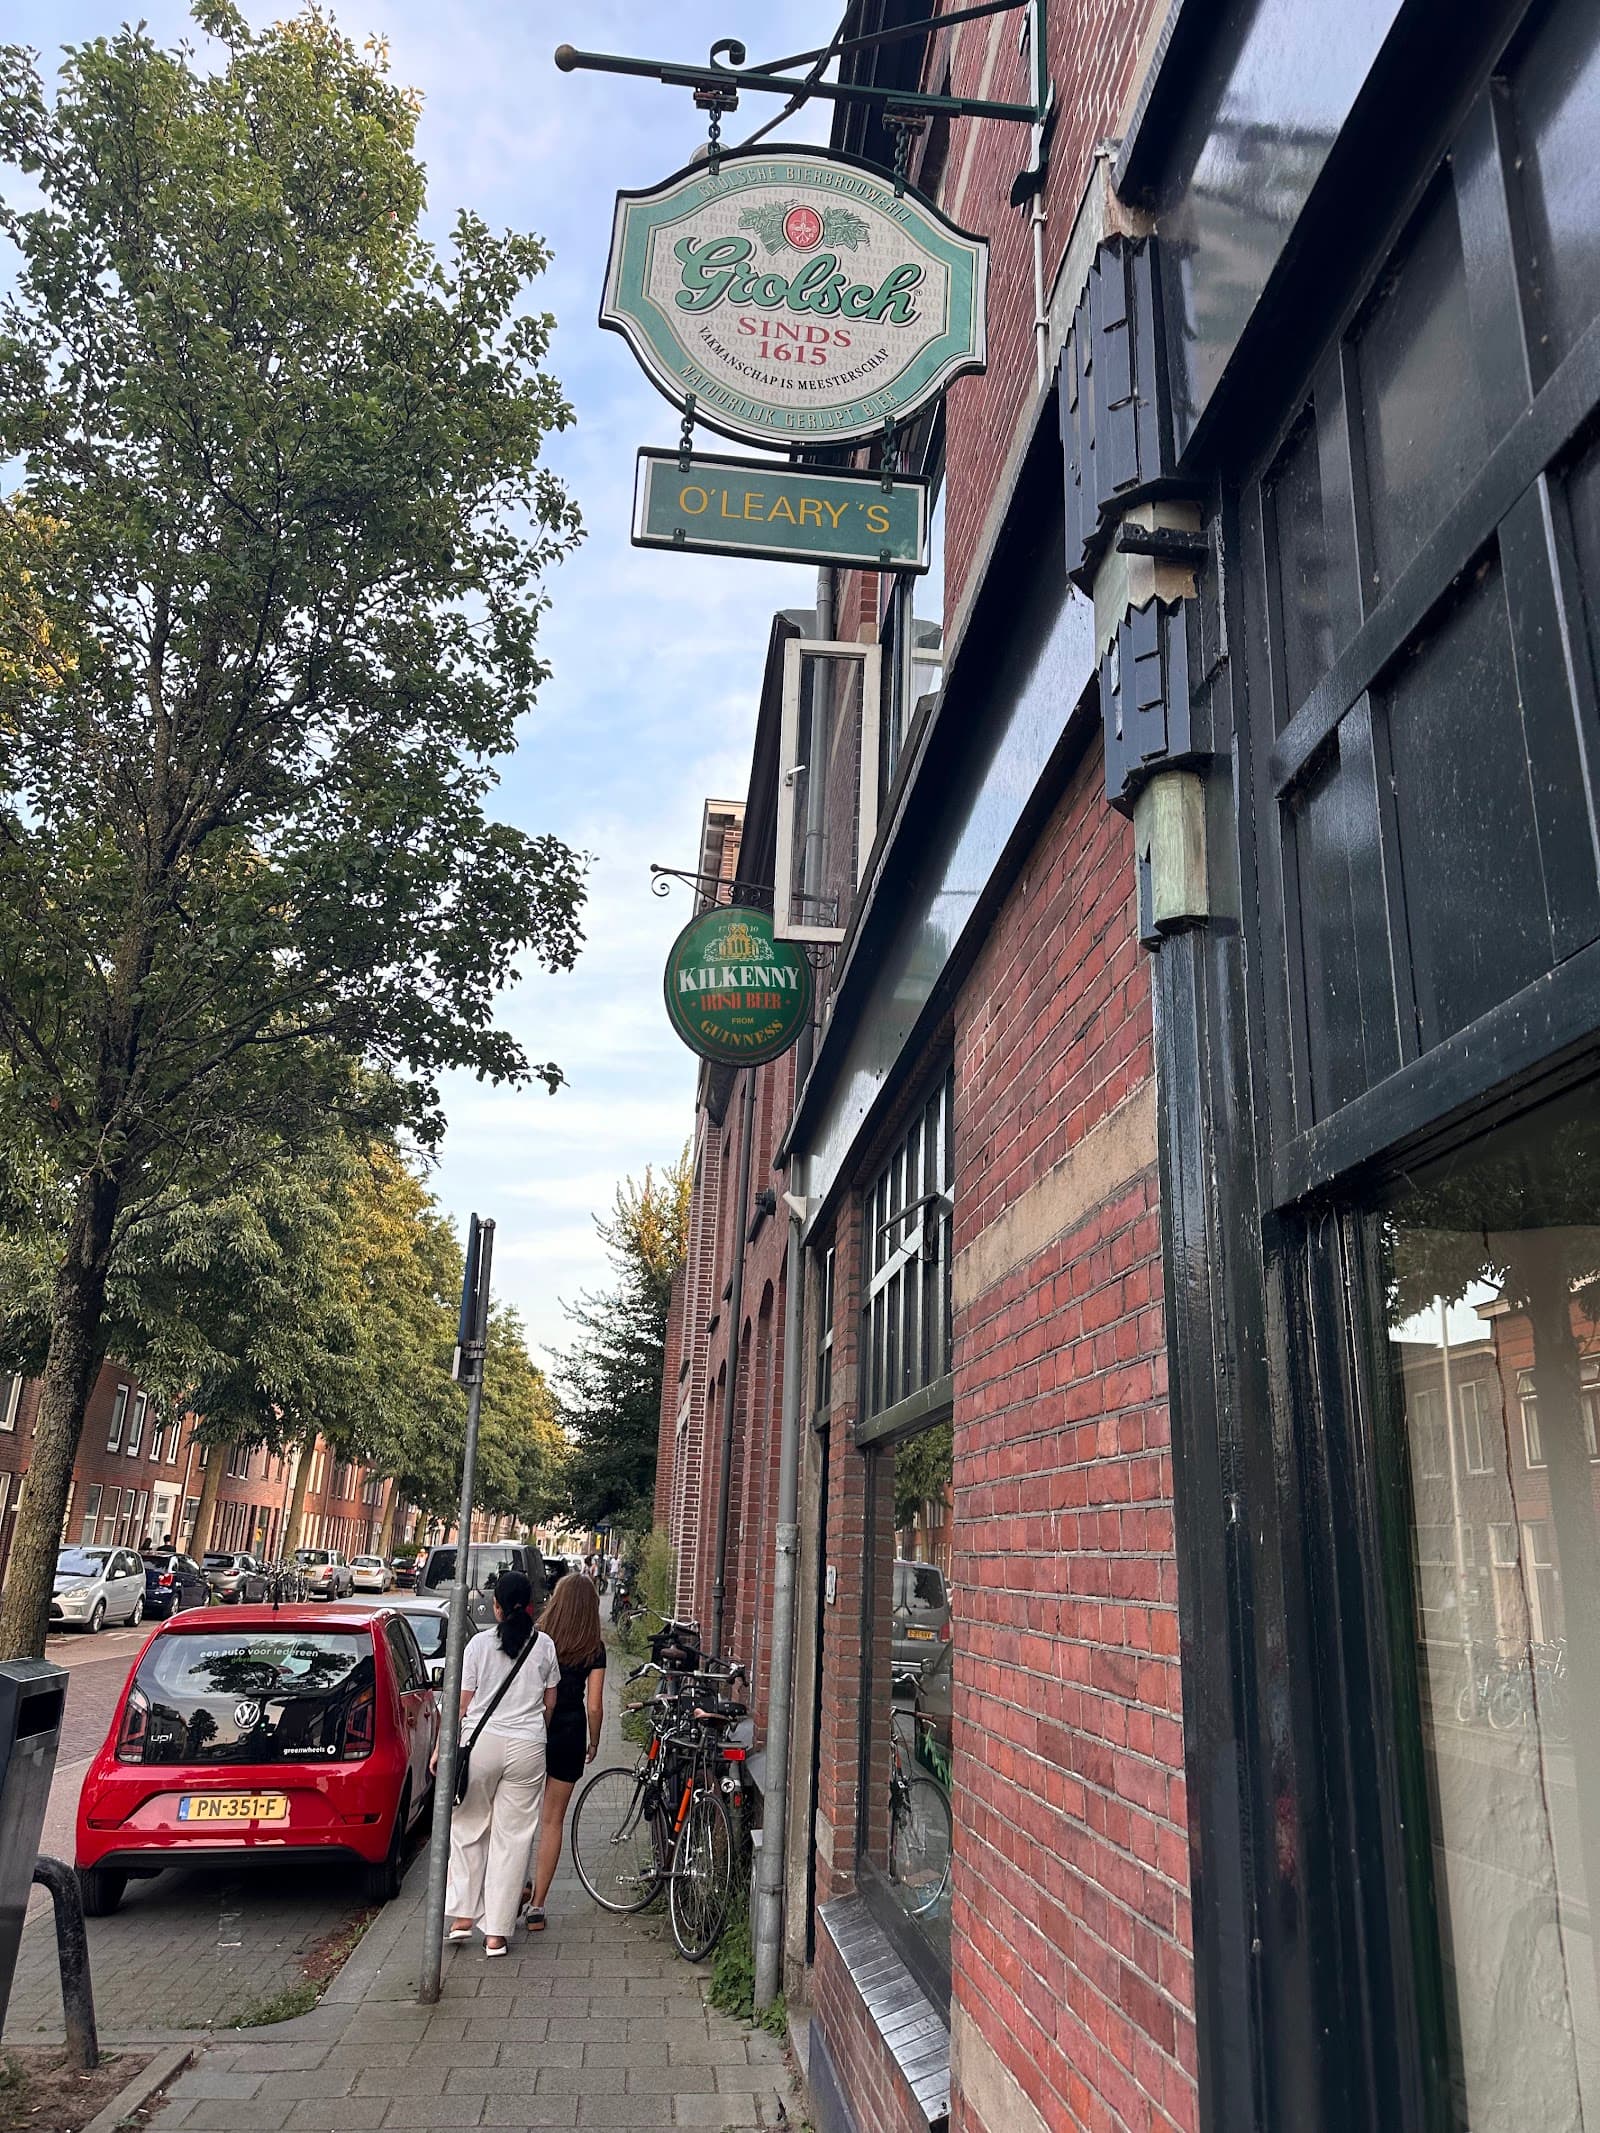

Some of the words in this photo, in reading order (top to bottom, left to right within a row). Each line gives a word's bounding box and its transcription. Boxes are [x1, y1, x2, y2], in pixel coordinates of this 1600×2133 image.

[697, 166, 777, 198] GROLSCHE
[786, 167, 911, 223] BIERBROUWERIJ
[673, 235, 924, 324] Grolsch
[736, 316, 852, 348] SINDS
[699, 325, 779, 387] VAKMANSCHAP
[780, 378, 794, 389] IS
[797, 347, 891, 391] MEESTERSCHAP
[759, 340, 828, 367] 1615
[679, 364, 776, 425] NATUURLIJK
[784, 408, 855, 429] GERIJPT
[862, 390, 900, 418] BIER
[678, 965, 801, 993] KILKENNY
[701, 992, 742, 1012] IRISH
[746, 991, 782, 1009] BEER
[700, 1019, 783, 1047] GUINNESS
[731, 1017, 754, 1025] FROM
[199, 1650, 219, 1658] een
[221, 1647, 246, 1657] auto
[248, 1647, 271, 1656] voor
[273, 1647, 319, 1657] iedereen
[283, 1746, 326, 1756] greenwheels
[196, 1798, 277, 1817] PN-351-F
